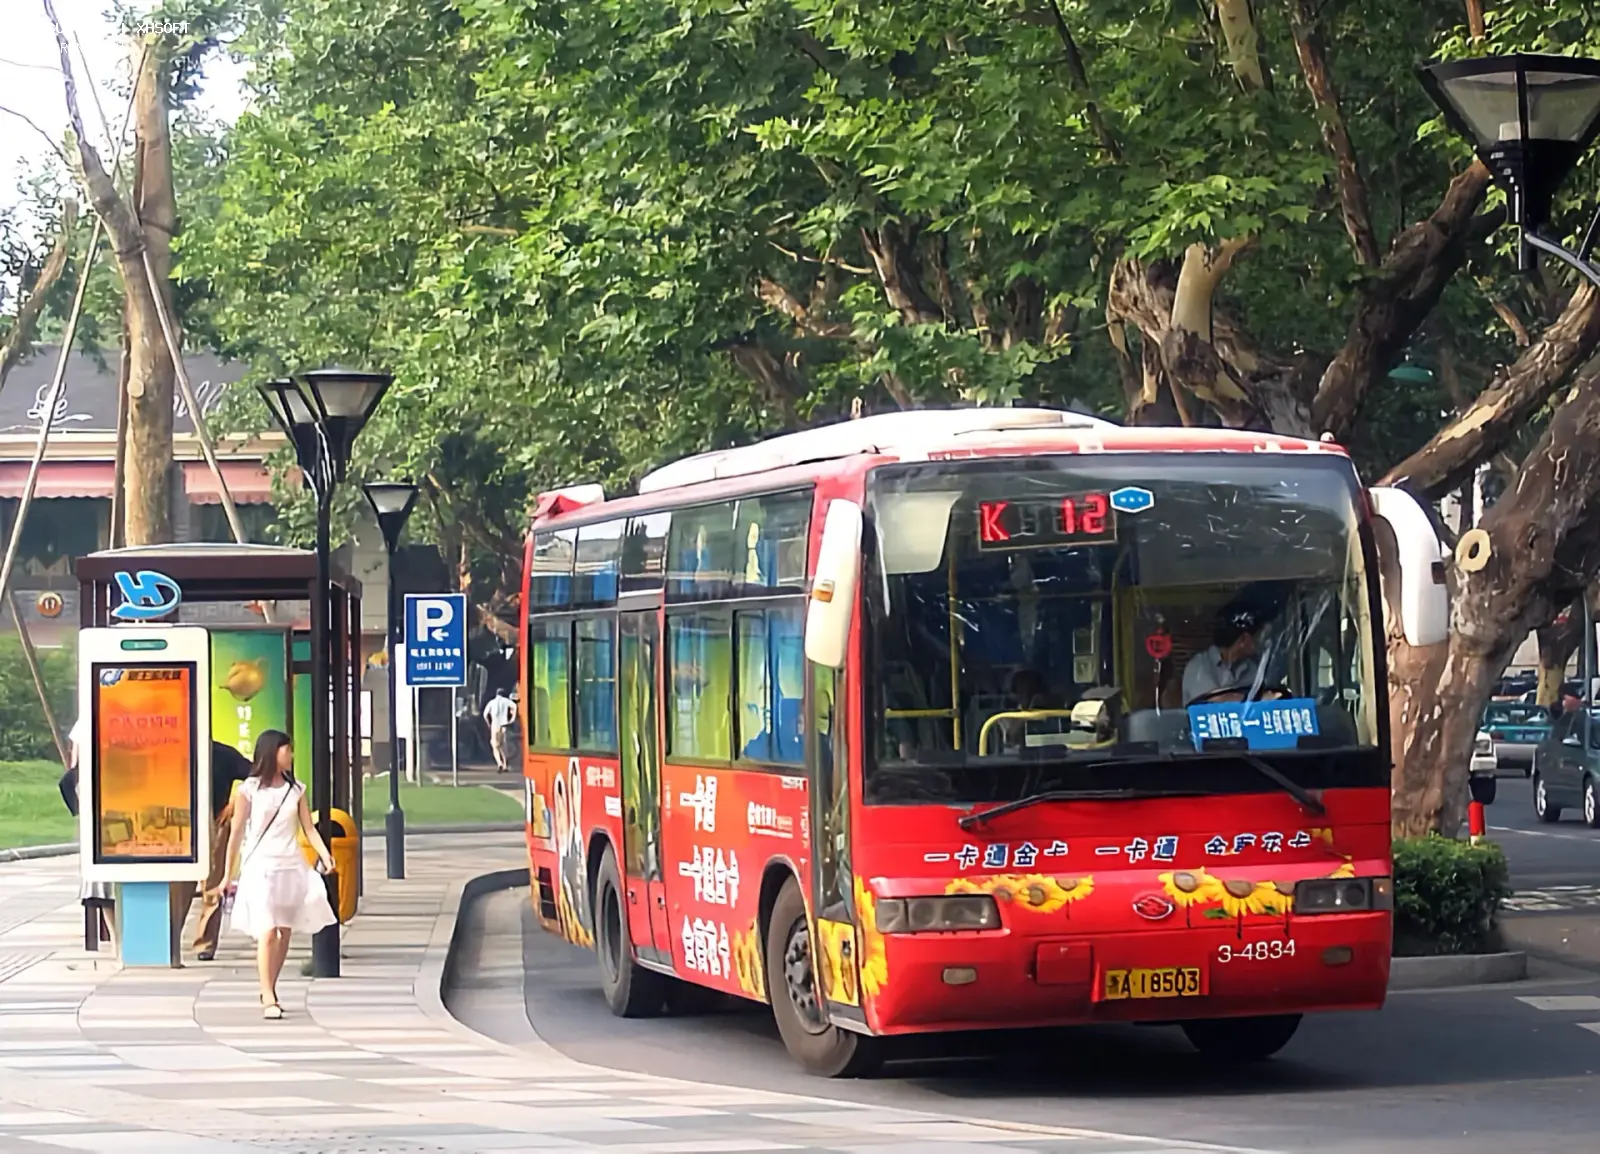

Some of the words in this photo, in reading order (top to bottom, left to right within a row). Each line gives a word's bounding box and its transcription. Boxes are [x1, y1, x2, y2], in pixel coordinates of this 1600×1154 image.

[981, 502, 1010, 541] K
[1061, 494, 1107, 534] 12
[416, 599, 453, 642] P
[1217, 939, 1297, 963] 3-4834
